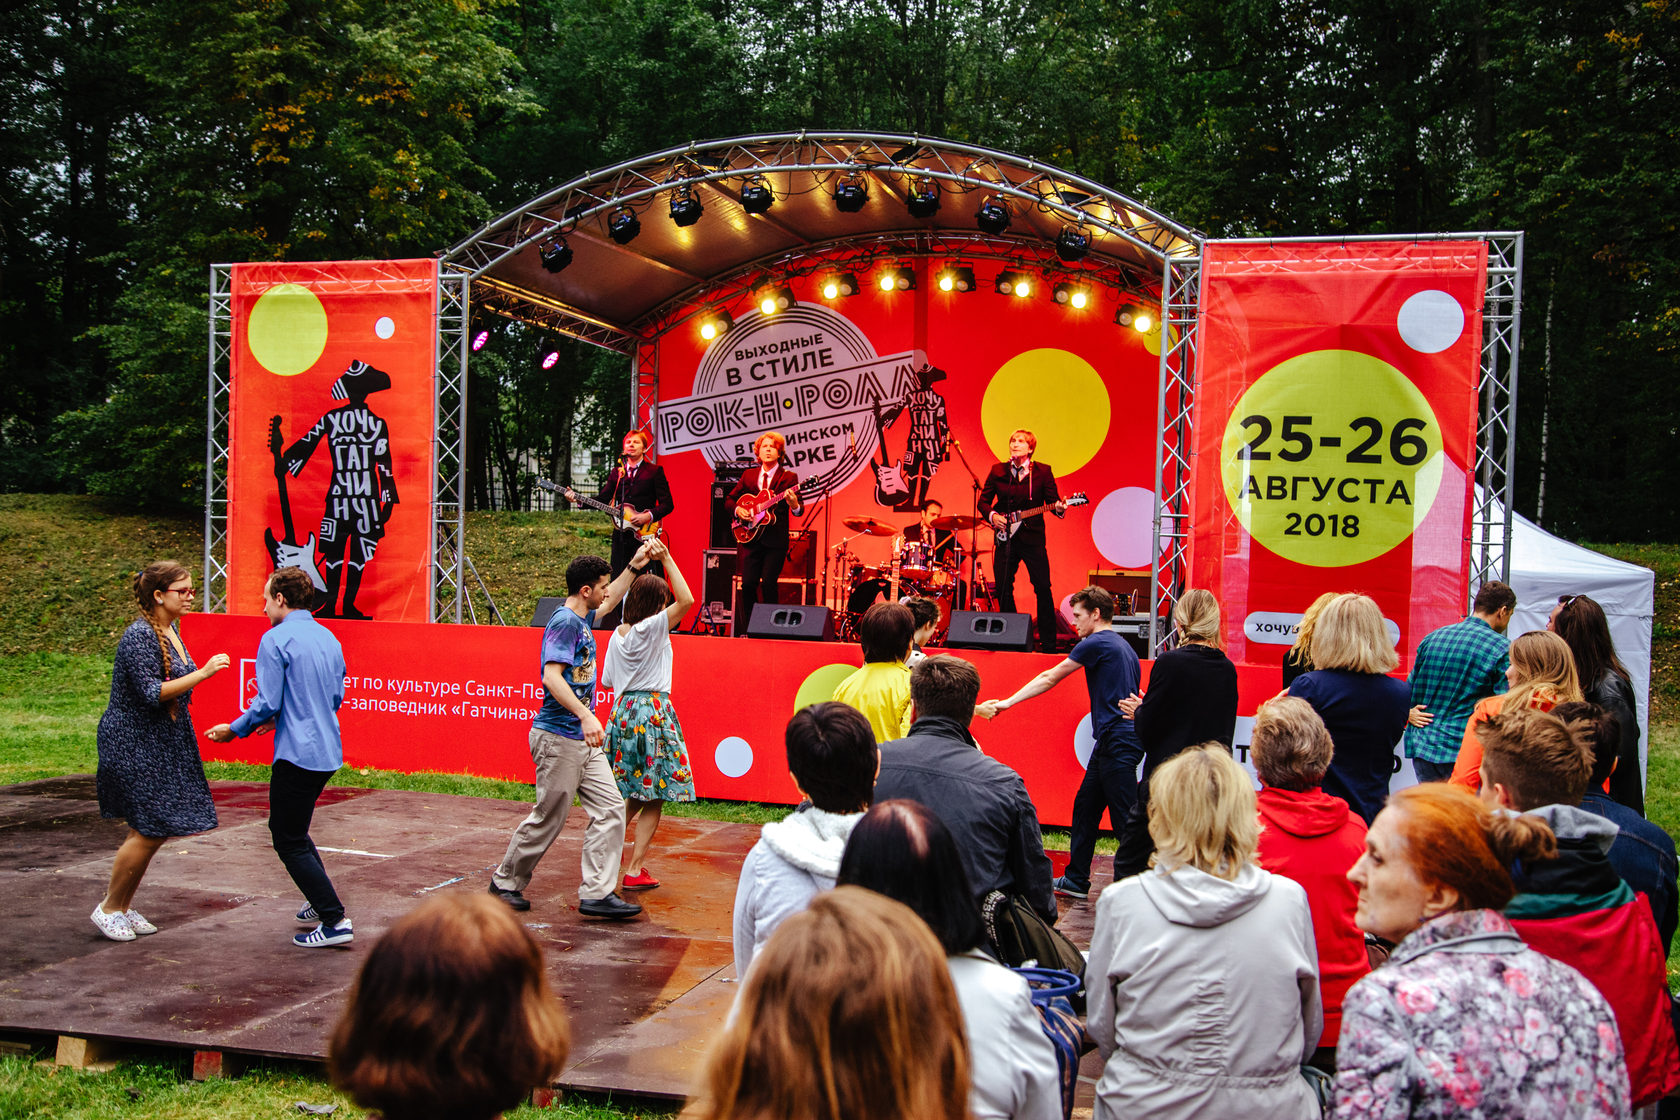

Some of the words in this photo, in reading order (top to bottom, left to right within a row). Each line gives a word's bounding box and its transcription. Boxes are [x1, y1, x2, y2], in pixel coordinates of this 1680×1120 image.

[735, 333, 824, 361] ВЫХОДНЫЕ
[726, 367, 742, 386] В
[750, 348, 835, 381] СТИЛЕ
[908, 391, 941, 410] ХОЧУ
[328, 409, 383, 443] ХОЧУ
[913, 410, 935, 425] ГАТ
[735, 444, 745, 455] В
[749, 422, 854, 453] ГИНСКОМ
[1237, 415, 1428, 466] 25-26
[335, 445, 372, 470] ГАТ
[778, 444, 837, 468] АРКЕ
[336, 471, 372, 496] ЧИ
[1238, 475, 1413, 505] АВГУСТА
[333, 498, 381, 534] НУ!
[1284, 512, 1360, 538] 2018
[363, 677, 383, 690] по
[387, 678, 460, 697] культуре
[451, 701, 538, 721] «Гатчина»
